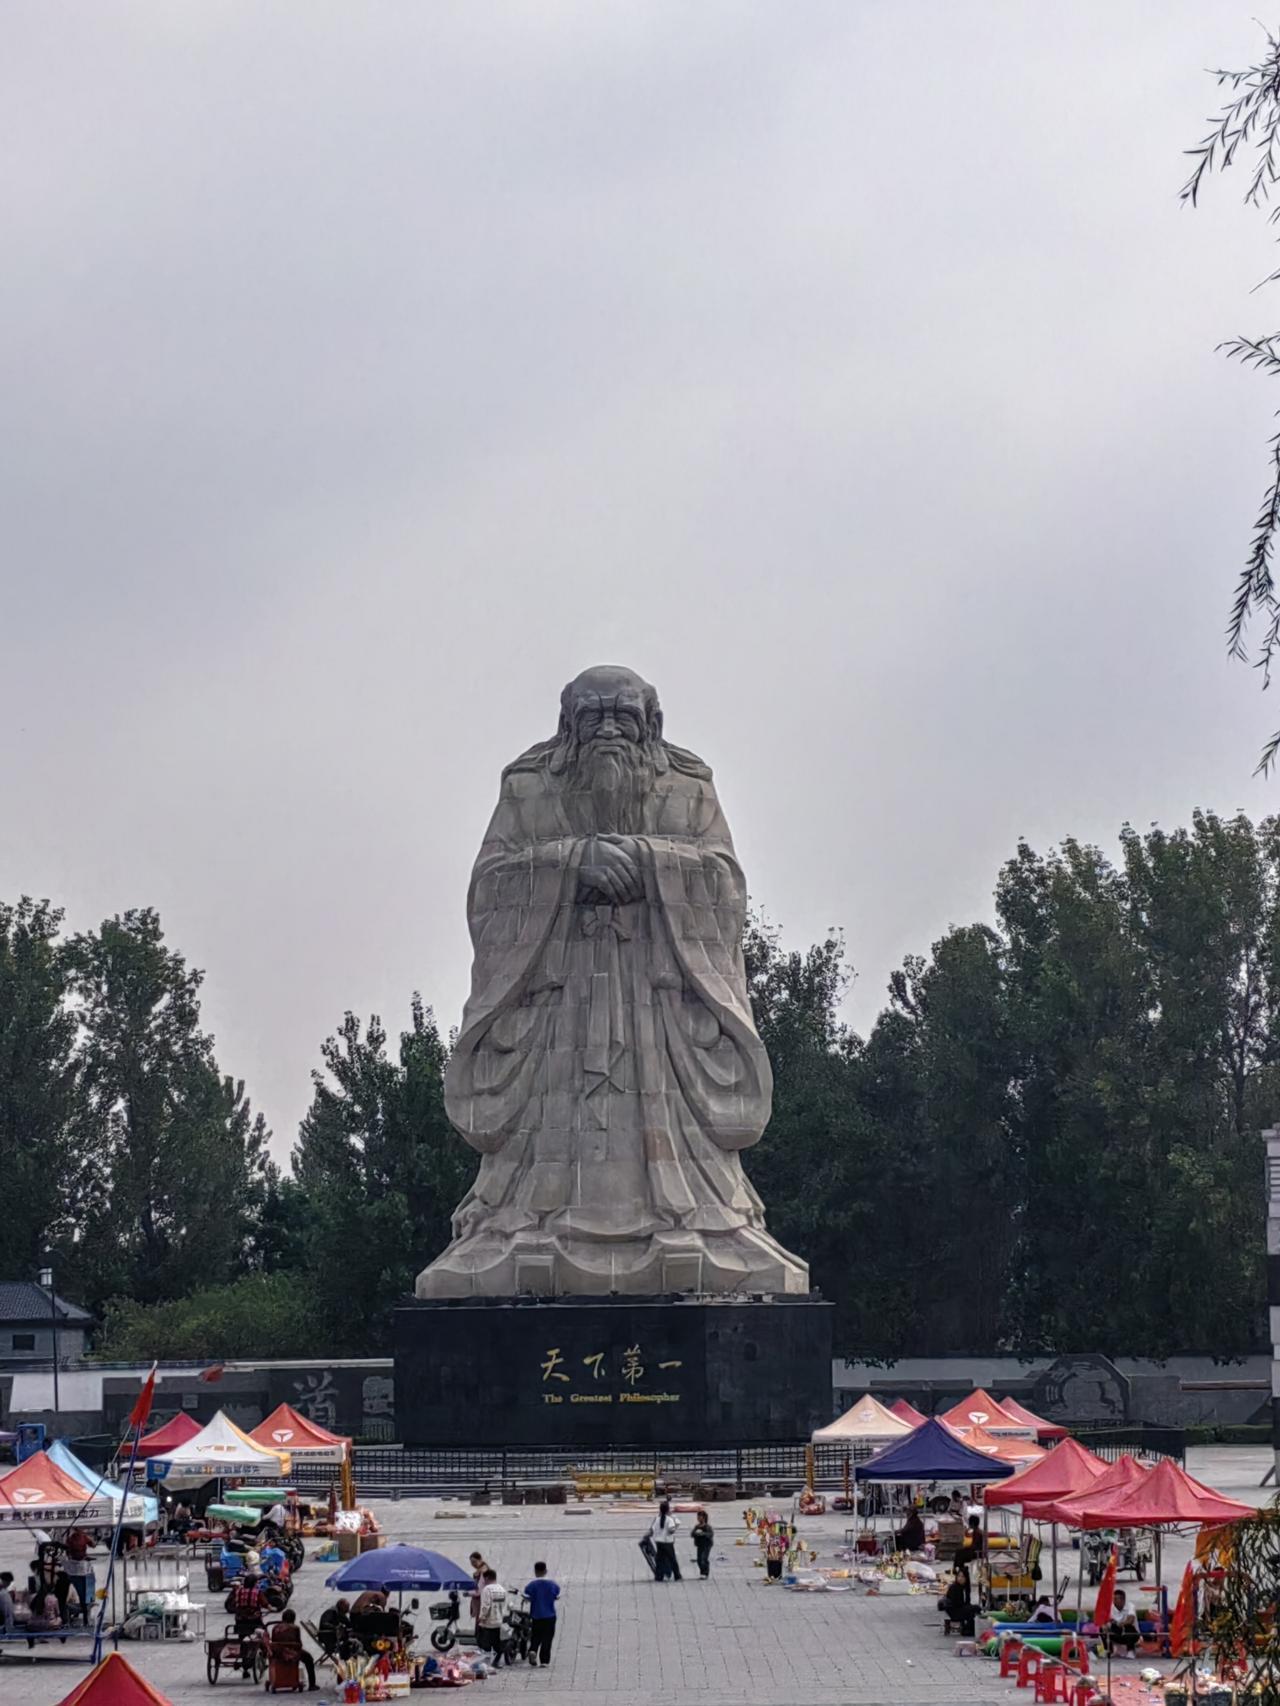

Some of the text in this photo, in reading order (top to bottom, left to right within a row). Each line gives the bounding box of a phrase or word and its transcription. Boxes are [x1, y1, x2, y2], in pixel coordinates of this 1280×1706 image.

[540, 1344, 683, 1386] 天下第一
[542, 1392, 681, 1404] The Greatest Philosopher
